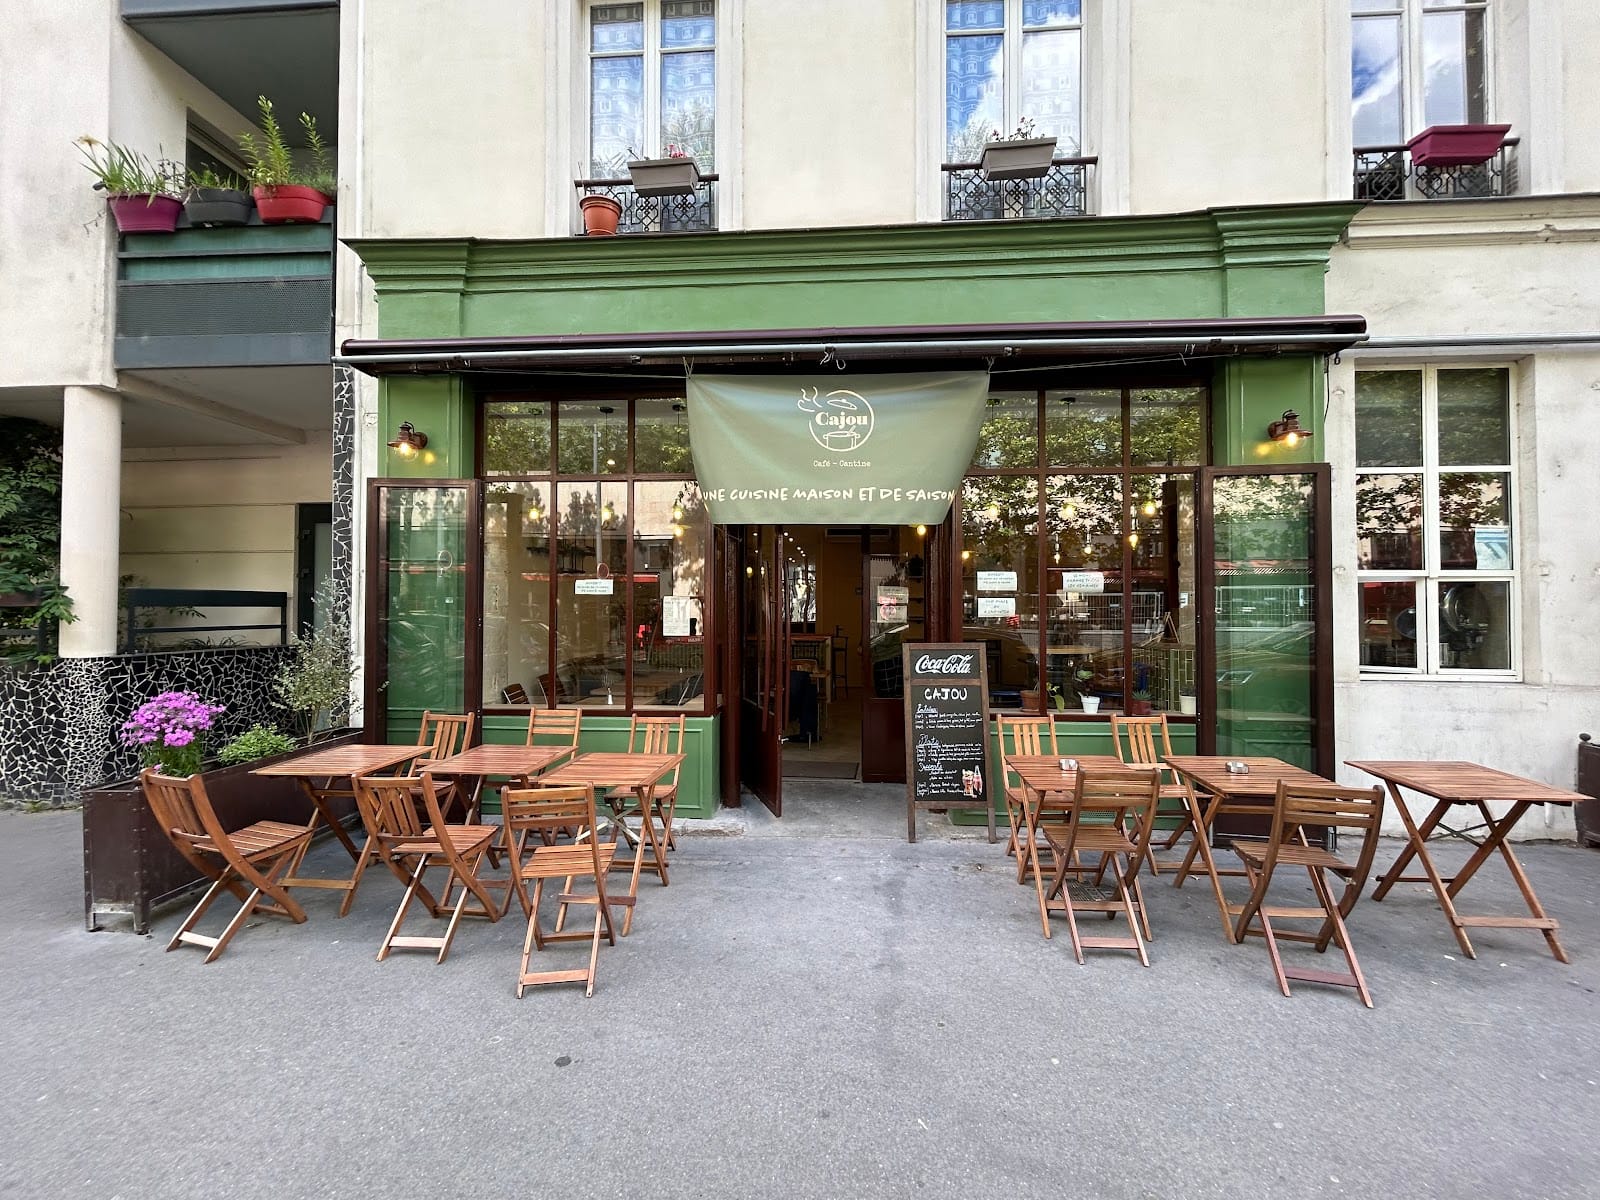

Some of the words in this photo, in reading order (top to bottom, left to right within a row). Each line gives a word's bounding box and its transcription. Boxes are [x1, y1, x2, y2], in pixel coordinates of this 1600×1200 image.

[815, 411, 868, 429] Cajou
[703, 488, 726, 502] UNE
[729, 488, 788, 501] CUISINE
[792, 488, 853, 501] MAISON
[859, 486, 877, 502] ET
[879, 488, 902, 502] DE
[905, 489, 955, 502] SAISON
[915, 654, 974, 674] Coca-Cola
[924, 687, 968, 701] CAJOU
